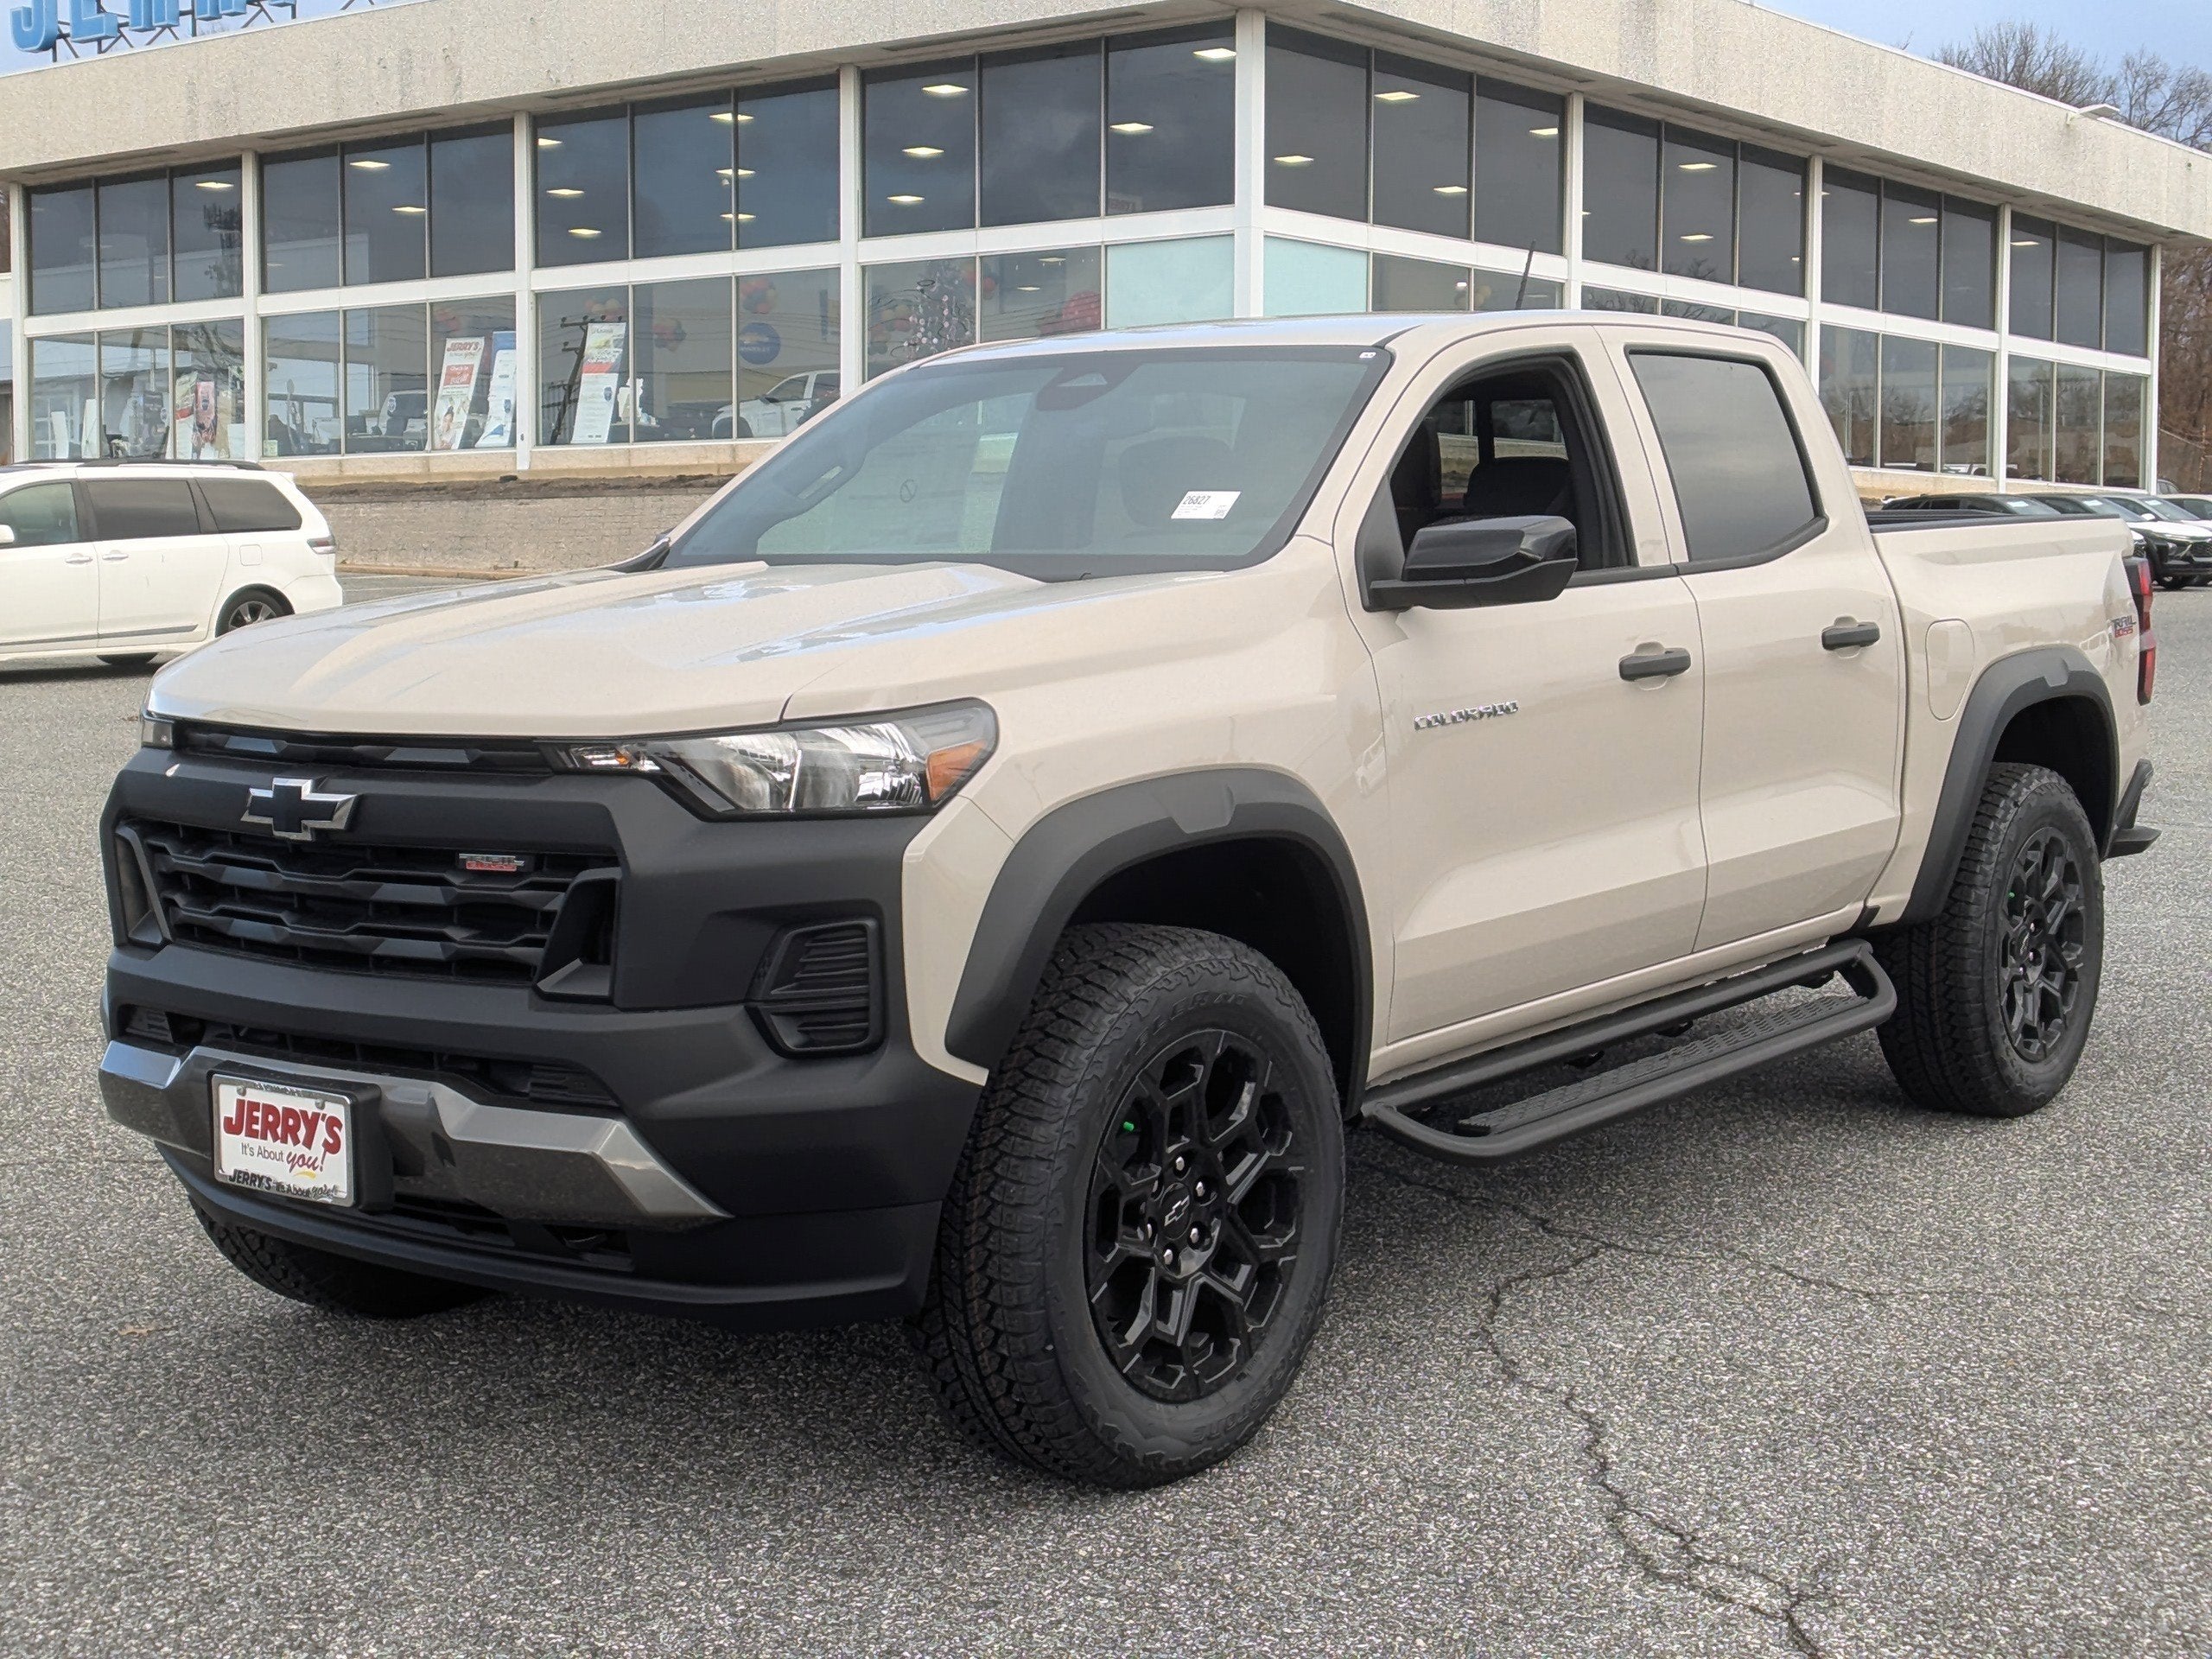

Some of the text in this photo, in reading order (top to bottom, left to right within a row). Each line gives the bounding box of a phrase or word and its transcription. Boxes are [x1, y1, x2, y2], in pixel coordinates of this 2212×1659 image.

[1182, 495, 1211, 505] 26827
[2111, 614, 2137, 628] TRAIL
[2114, 626, 2133, 638] BOSS
[1414, 701, 1519, 731] COLORADO
[223, 1098, 343, 1155] JERRY'S
[241, 1142, 327, 1173] It's About you!
[228, 1168, 273, 1191] JERRY'S
